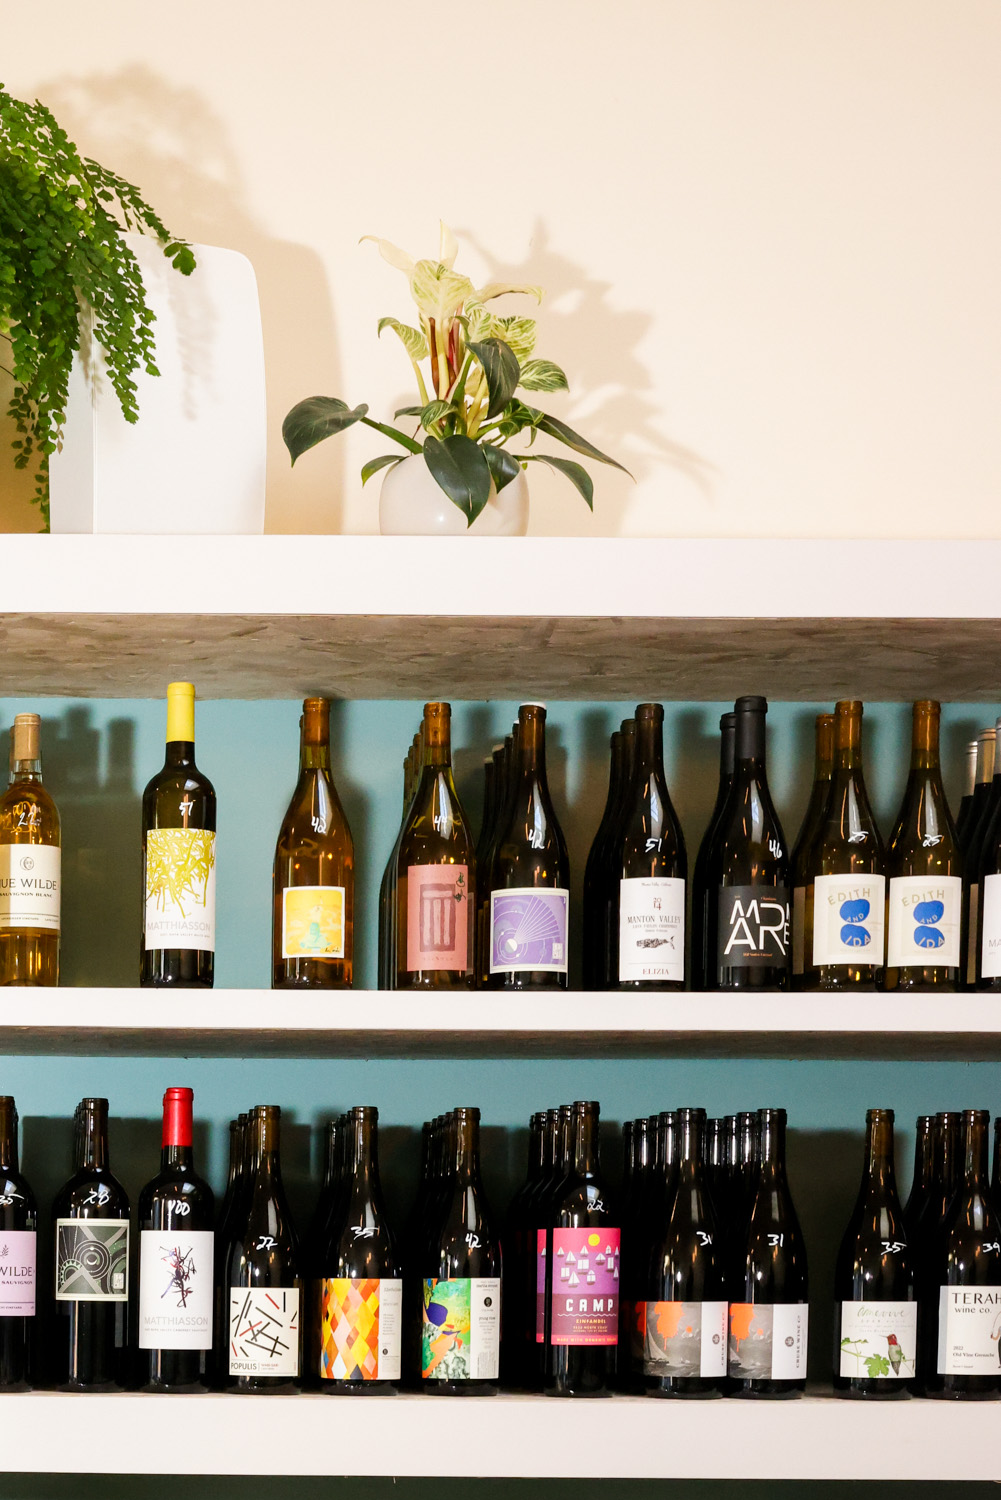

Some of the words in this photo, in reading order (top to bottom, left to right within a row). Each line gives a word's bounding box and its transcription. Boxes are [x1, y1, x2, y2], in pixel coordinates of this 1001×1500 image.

[18, 812, 36, 826] 22
[311, 817, 327, 833] 42
[528, 829, 545, 850] 42
[645, 838, 662, 852] 51
[923, 835, 942, 847] 25
[21, 879, 56, 890] WILDE
[827, 888, 871, 905] EDITH
[902, 890, 945, 906] EDITH
[846, 913, 864, 923] AND
[920, 914, 938, 924] AND
[147, 921, 210, 931] MATTHIASSON
[846, 935, 871, 947] IDA
[919, 937, 945, 949] IDA
[465, 1233, 481, 1248] 42
[696, 1231, 712, 1246] 31
[767, 1233, 784, 1247] 31
[881, 1242, 907, 1255] 35
[566, 1298, 613, 1312] CAMP
[145, 1316, 208, 1326] MATTHIASSON
[231, 1362, 257, 1370] POPULIS
